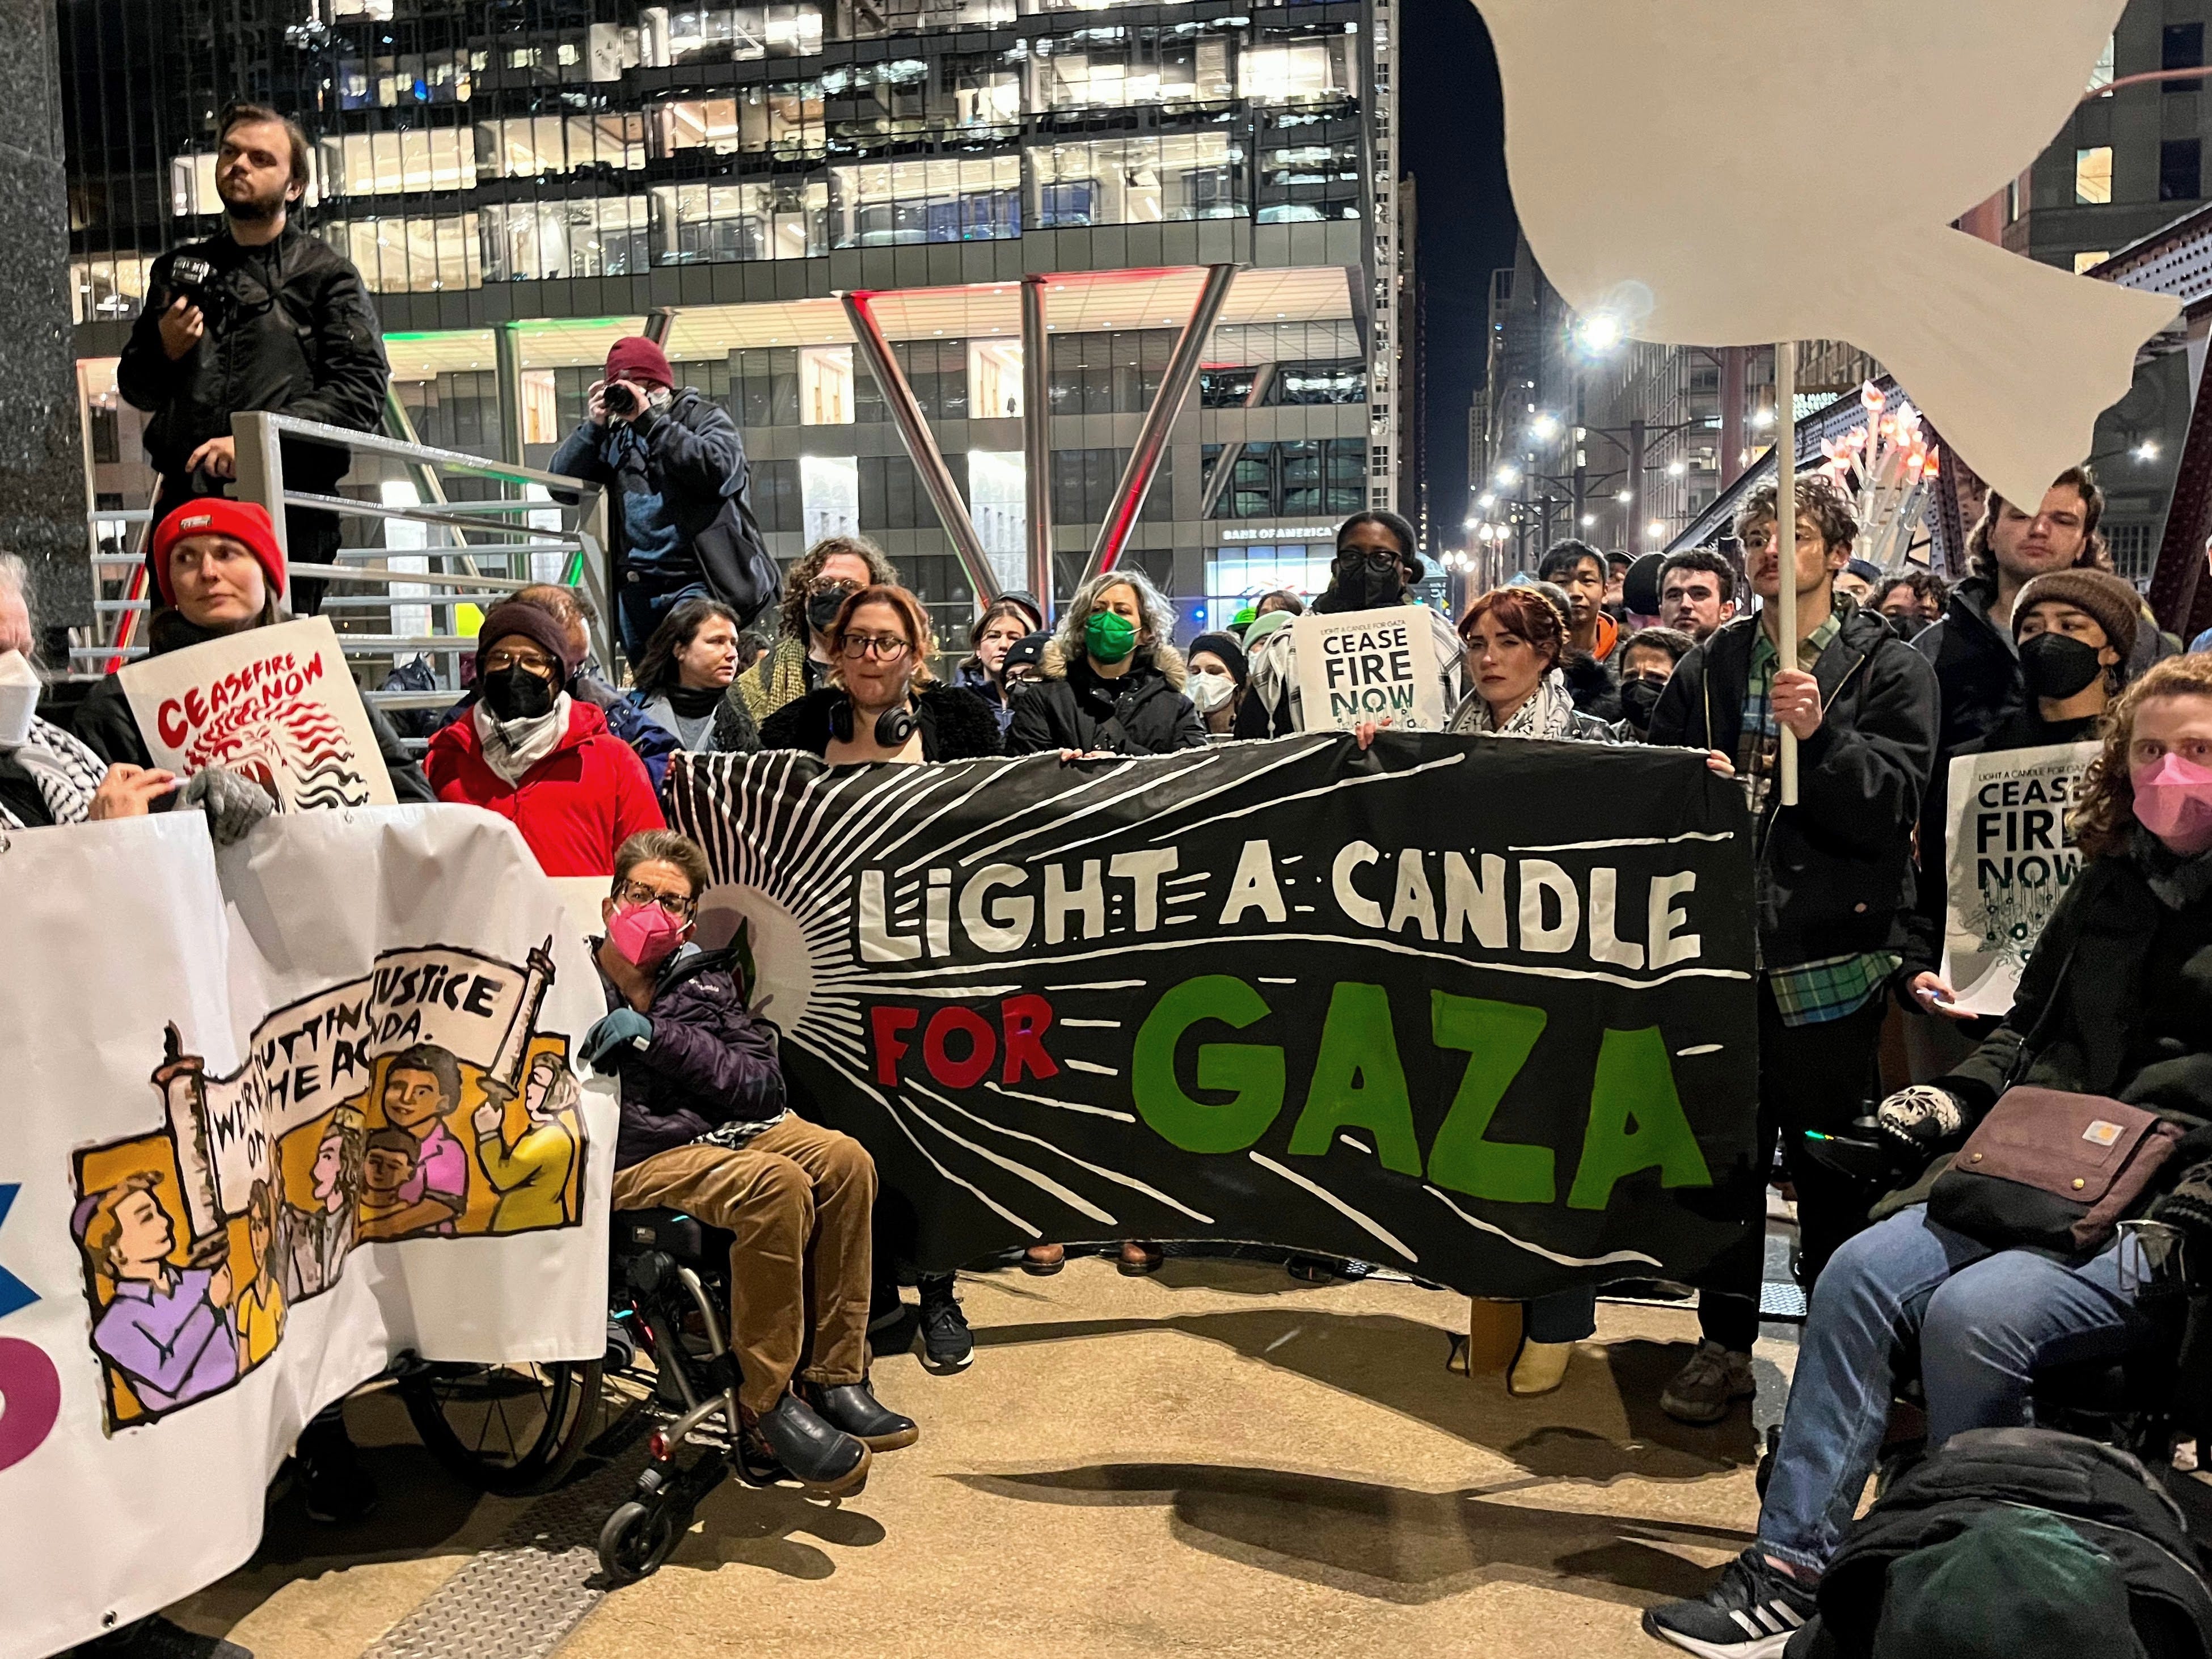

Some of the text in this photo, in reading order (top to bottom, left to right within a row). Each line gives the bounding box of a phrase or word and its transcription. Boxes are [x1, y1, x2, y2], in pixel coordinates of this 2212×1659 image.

[1222, 526, 1333, 540] BANK OF AMERICA
[1323, 628, 1408, 655] CEASE
[1346, 624, 1372, 632] CANDLE
[262, 651, 323, 708] NOW
[1325, 650, 1413, 689] FIRE
[158, 651, 296, 749] CEASEFIRE
[1330, 683, 1414, 717] NOW
[1979, 771, 2002, 782] LIGHT
[2011, 768, 2042, 778] CANDLE
[1219, 839, 1286, 925] A
[1332, 841, 1701, 970] CANDLE
[871, 974, 1713, 1210] FOR GAZA
